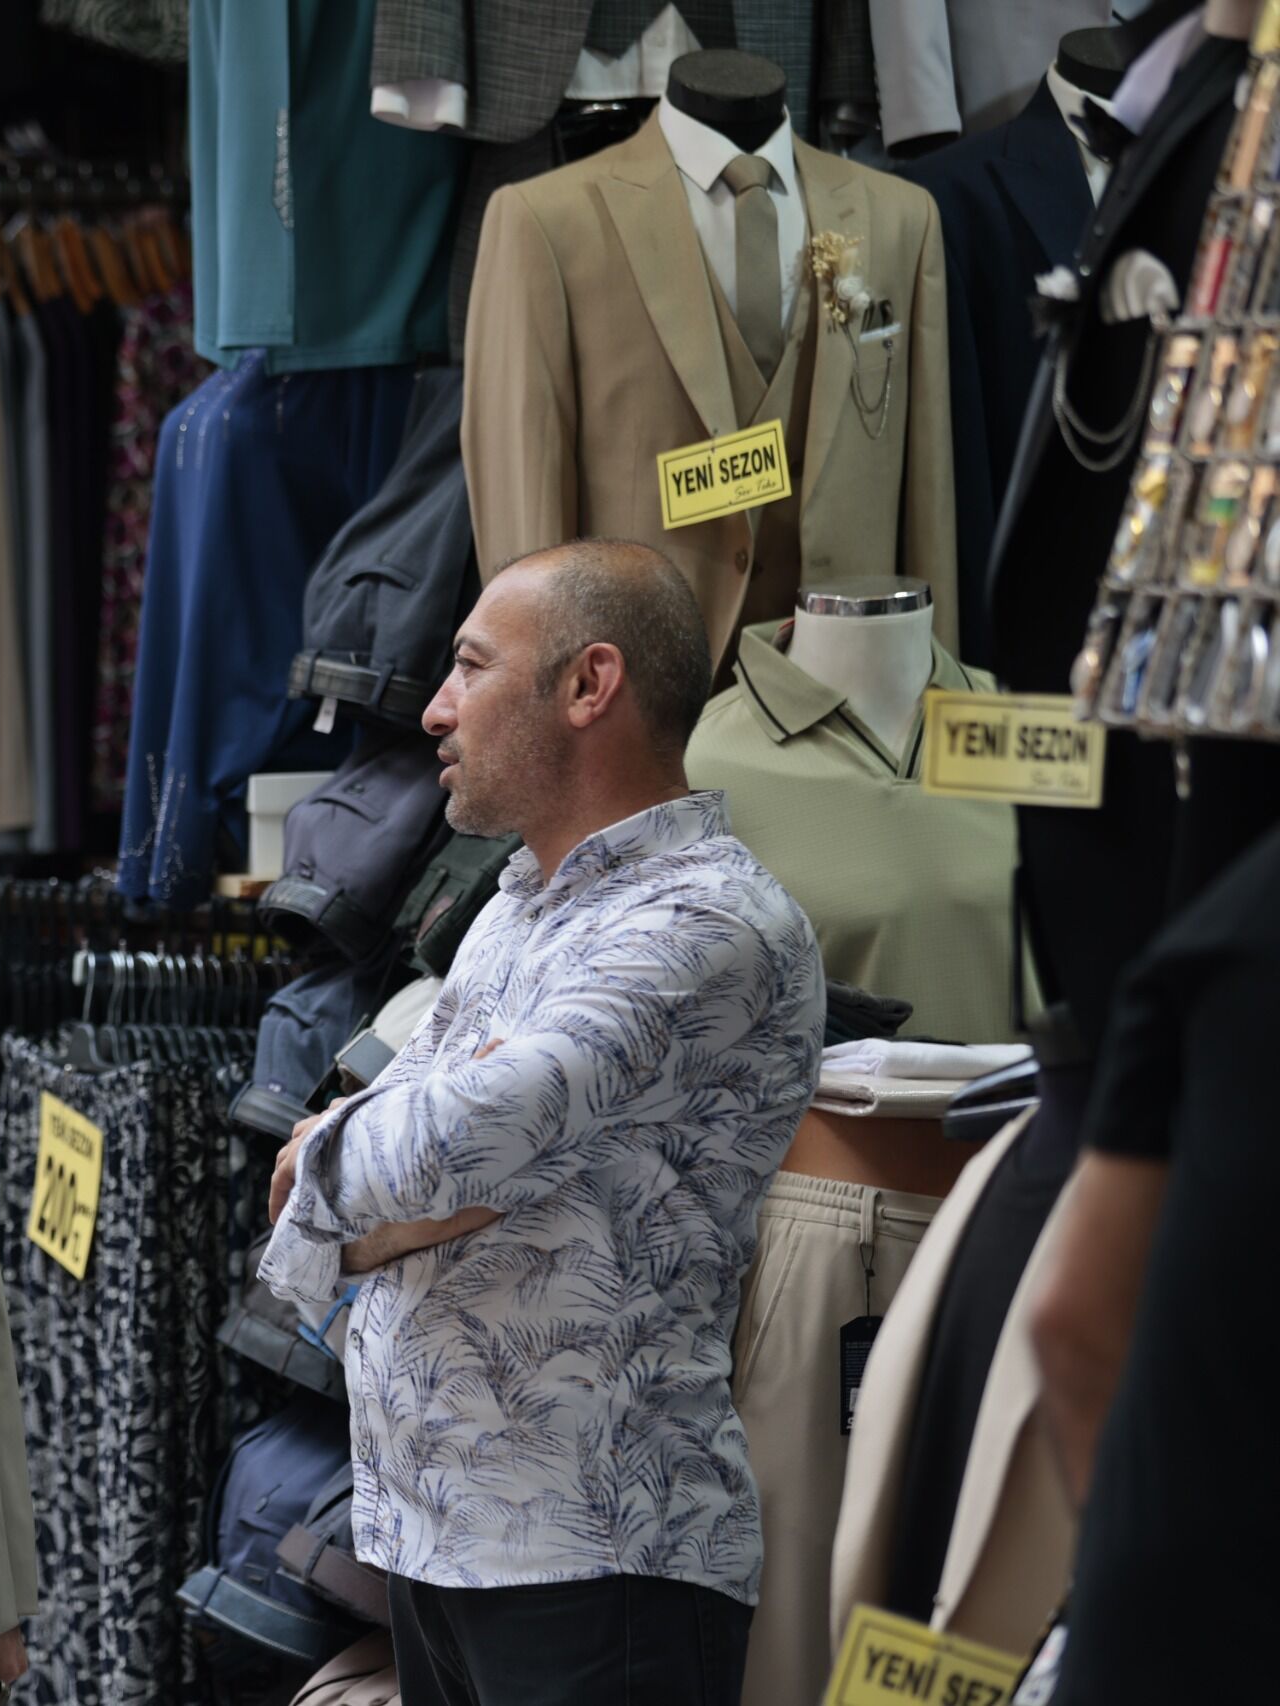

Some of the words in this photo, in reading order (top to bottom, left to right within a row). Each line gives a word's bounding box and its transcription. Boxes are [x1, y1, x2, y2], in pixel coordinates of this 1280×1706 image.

[671, 454, 715, 498] YENİ
[719, 443, 777, 485] SEZON
[944, 713, 1009, 760] YENİ
[1017, 724, 1088, 763] SEZON
[863, 1644, 940, 1701] YENİ
